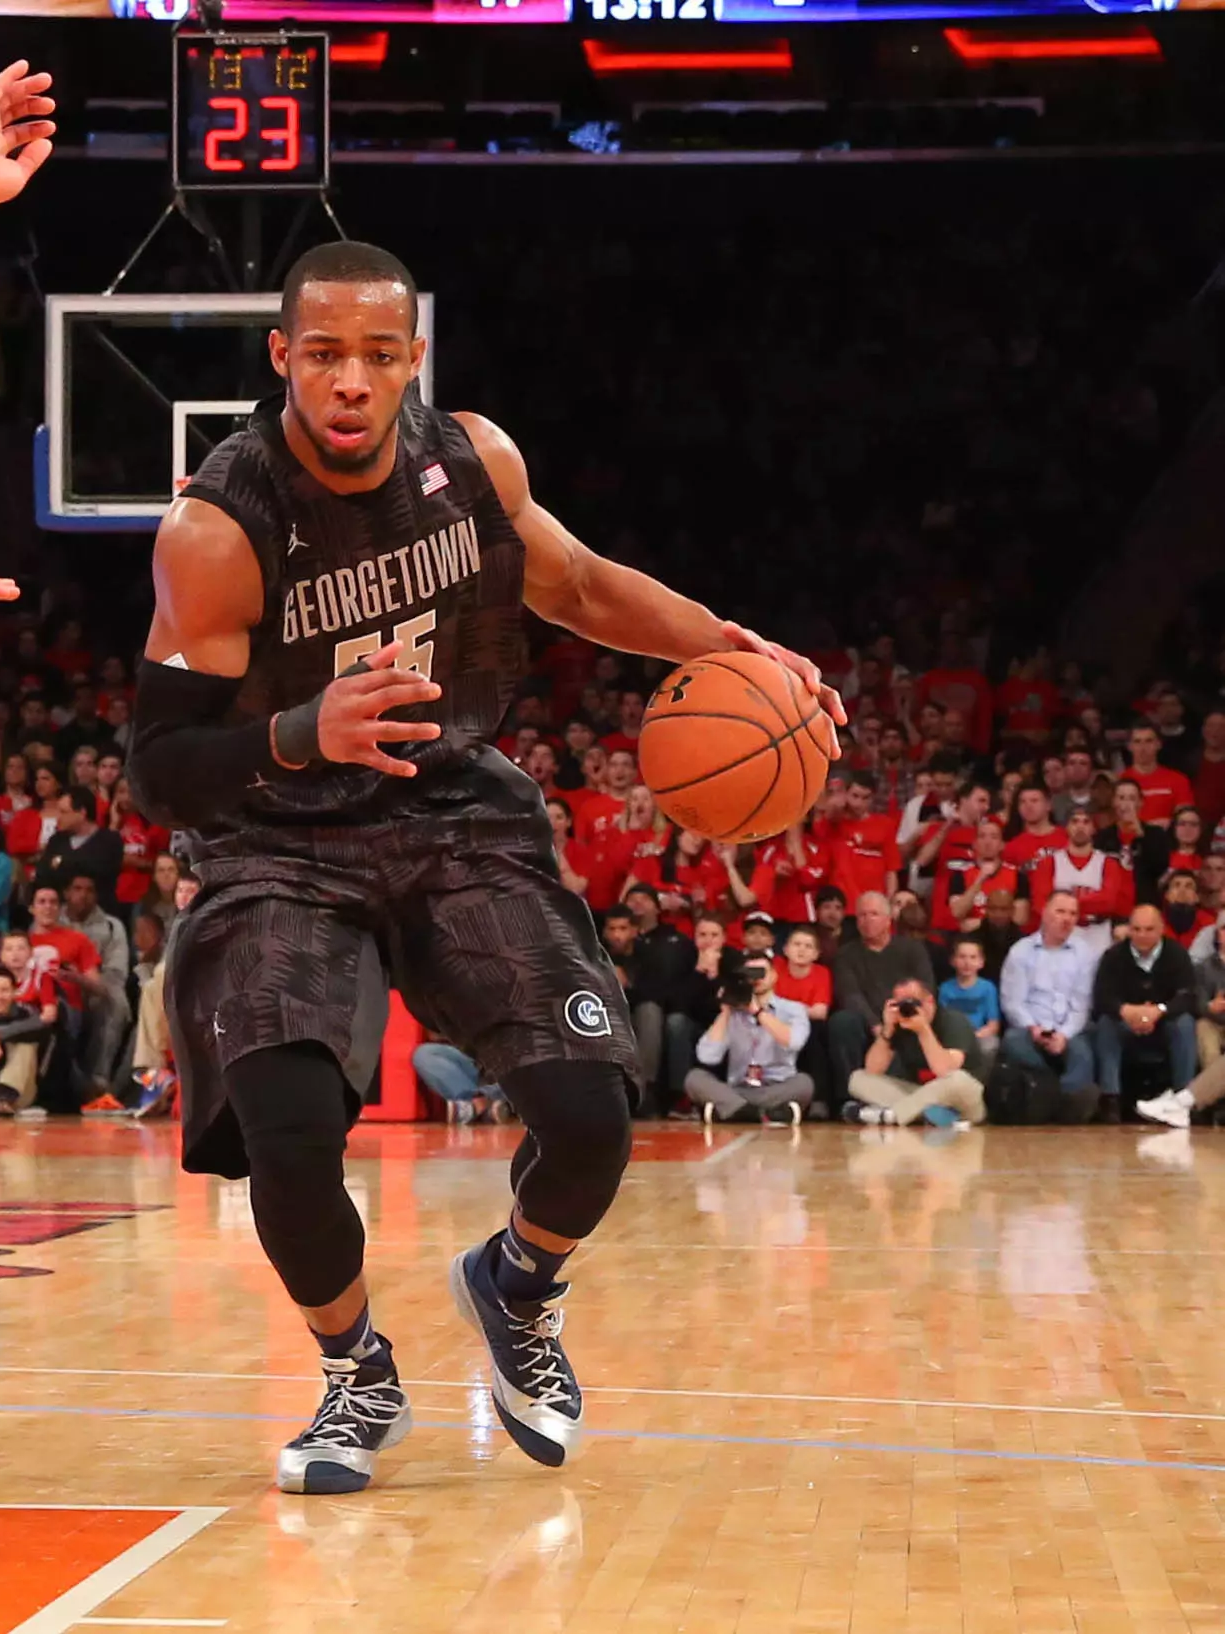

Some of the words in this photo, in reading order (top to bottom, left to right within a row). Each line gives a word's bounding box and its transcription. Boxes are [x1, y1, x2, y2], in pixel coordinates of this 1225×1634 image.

[209, 53, 241, 89] 13
[275, 53, 307, 89] 12
[205, 97, 299, 171] 23
[283, 516, 481, 644] GEORGETOWN
[565, 990, 611, 1037] G
